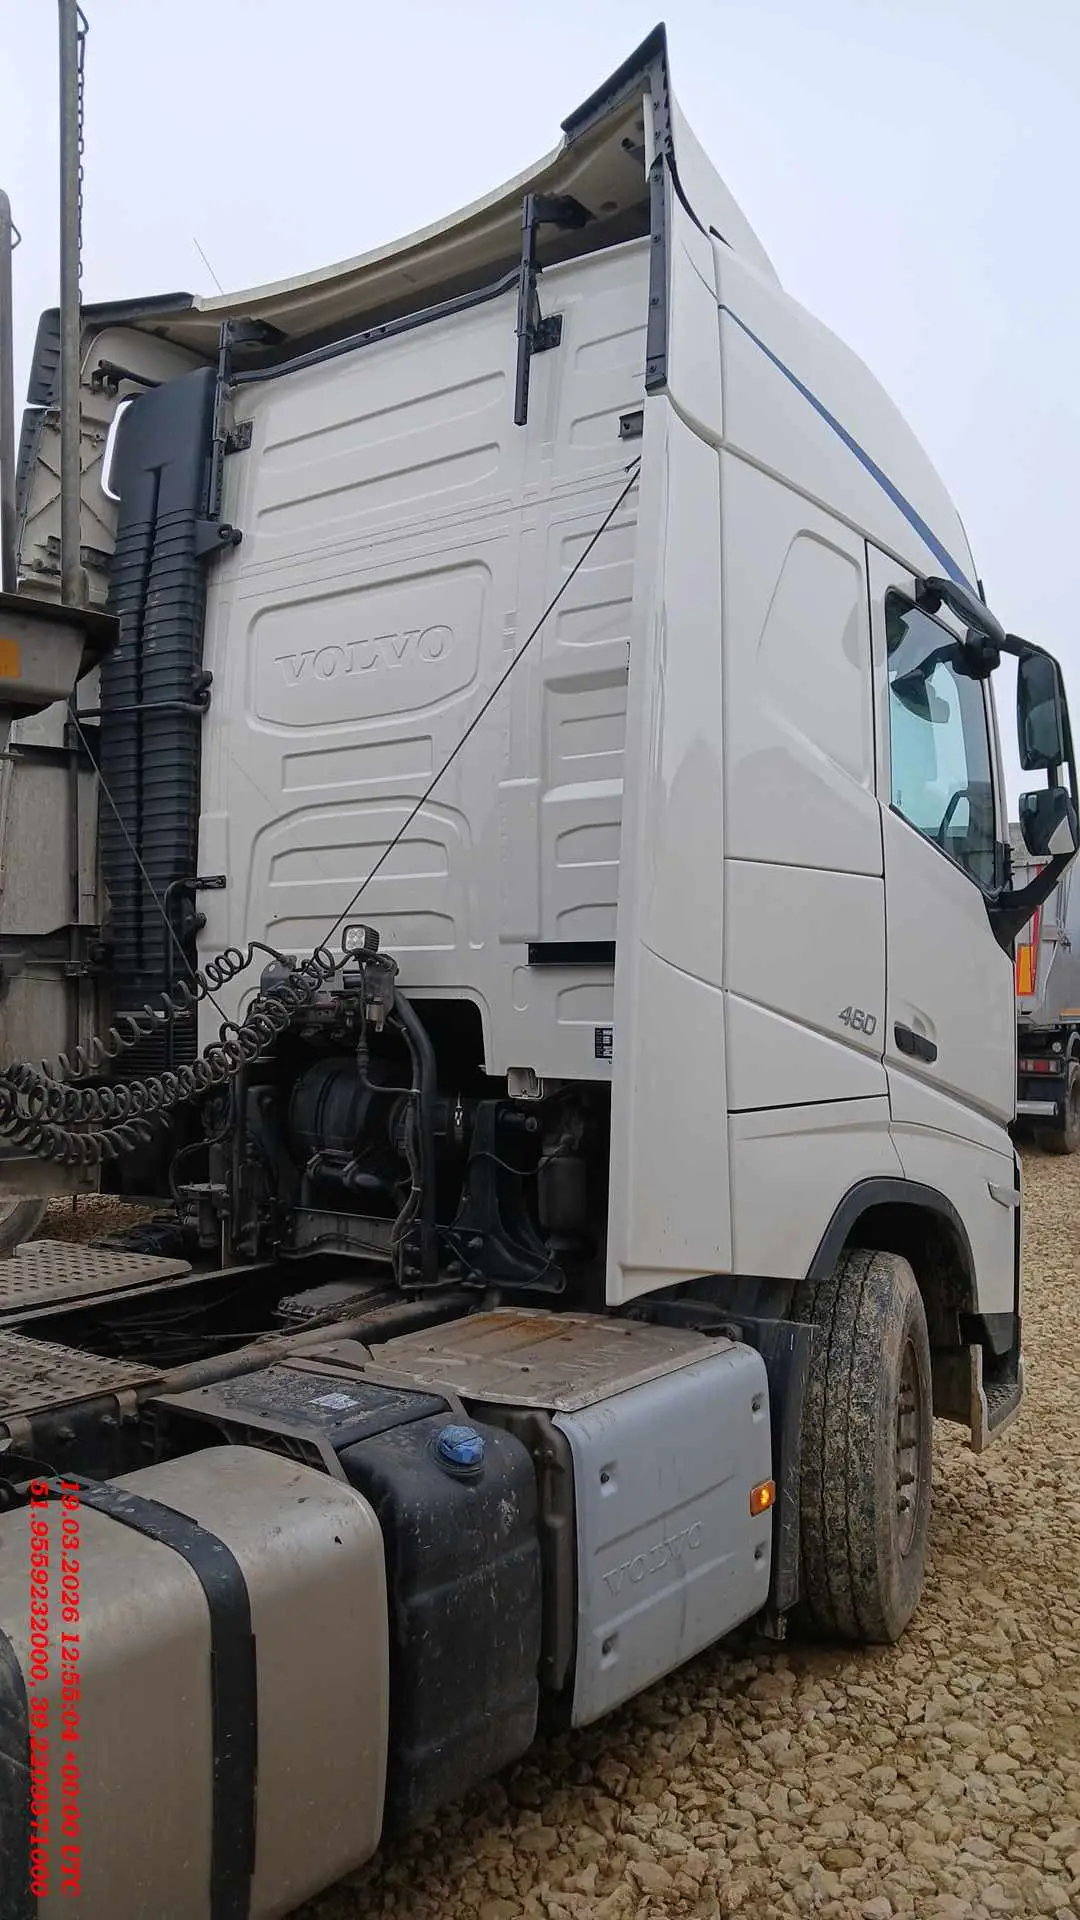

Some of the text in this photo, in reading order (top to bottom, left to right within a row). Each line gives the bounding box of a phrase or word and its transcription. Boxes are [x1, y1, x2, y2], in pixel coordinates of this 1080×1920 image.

[273, 624, 455, 688] VOLVO
[838, 1005, 877, 1036] 460
[601, 1520, 703, 1597] VOLVO
